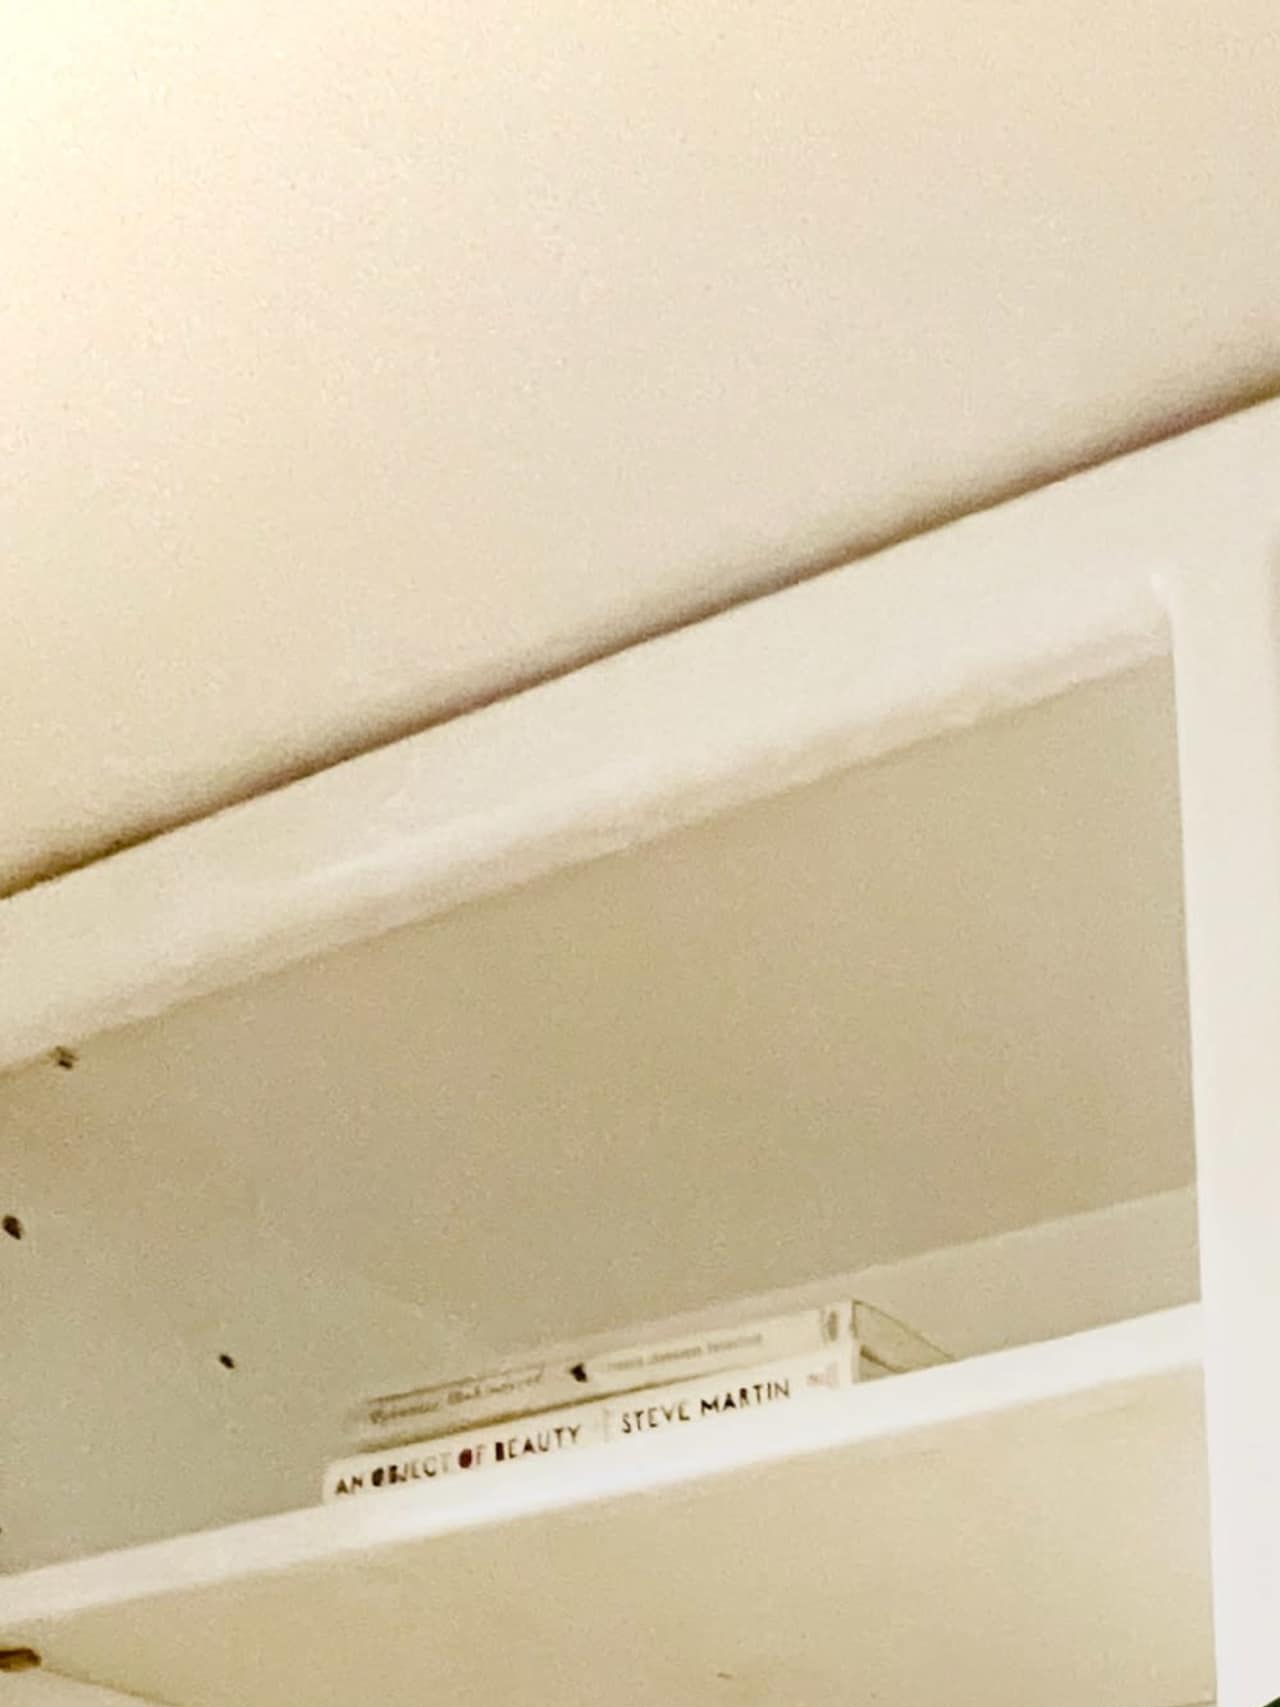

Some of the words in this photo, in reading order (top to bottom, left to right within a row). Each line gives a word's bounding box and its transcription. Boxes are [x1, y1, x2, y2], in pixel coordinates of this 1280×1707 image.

[621, 1400, 691, 1434] STEVE
[700, 1378, 791, 1418] MARTIN
[494, 1424, 581, 1462] BEAUTY
